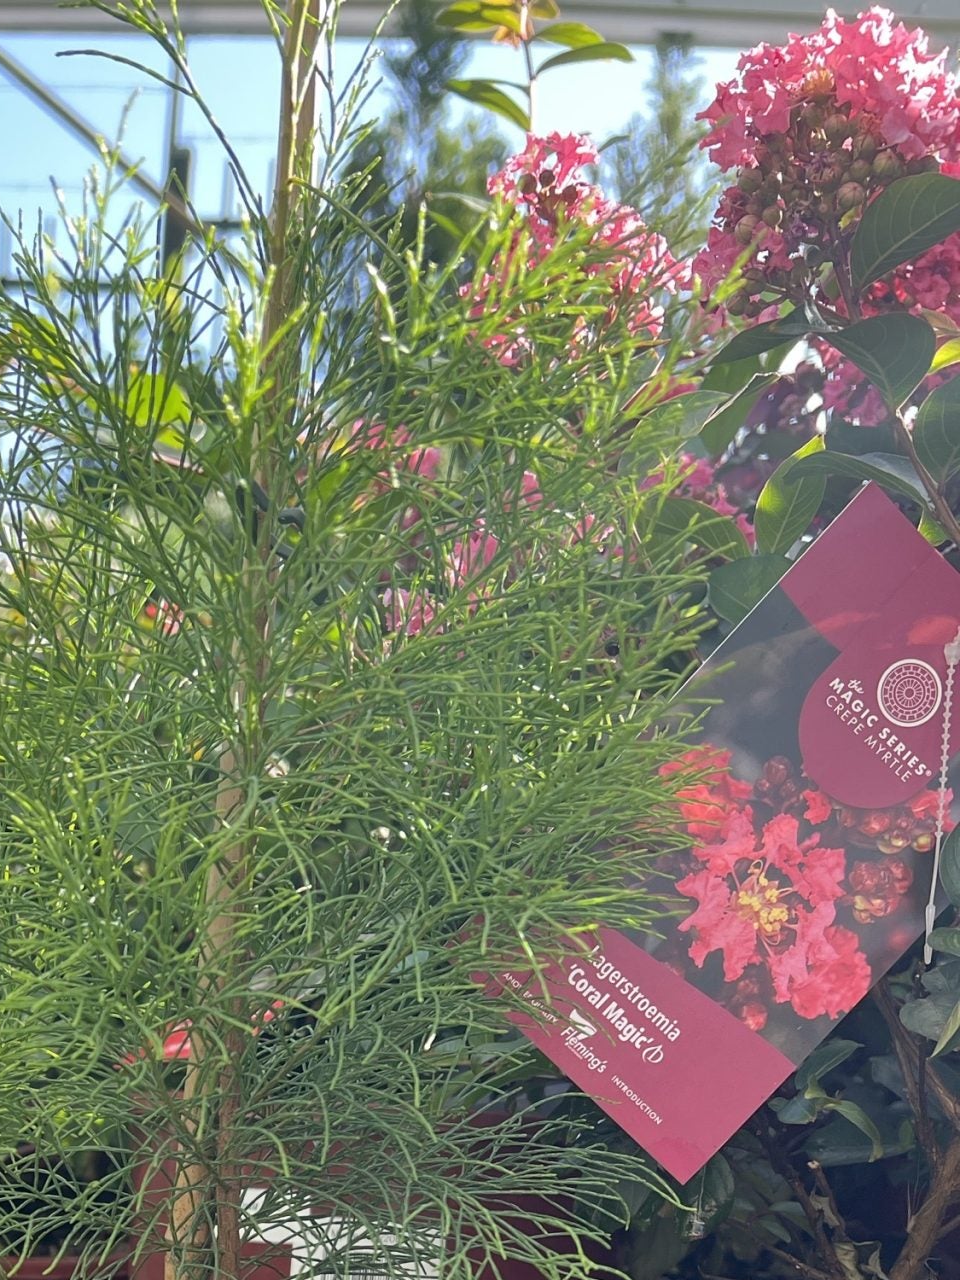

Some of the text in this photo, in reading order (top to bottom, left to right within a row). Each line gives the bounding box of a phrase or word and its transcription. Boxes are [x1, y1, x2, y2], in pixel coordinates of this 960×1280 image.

[829, 678, 878, 727] MAGIC
[848, 679, 864, 694] the
[826, 695, 913, 783] CREPE MYRTLE
[567, 964, 611, 1015] 'Coral
[588, 945, 681, 1042] Lagerstroemia
[560, 1026, 608, 1073] Fleming's
[611, 1075, 663, 1125] INTRODUCTION
